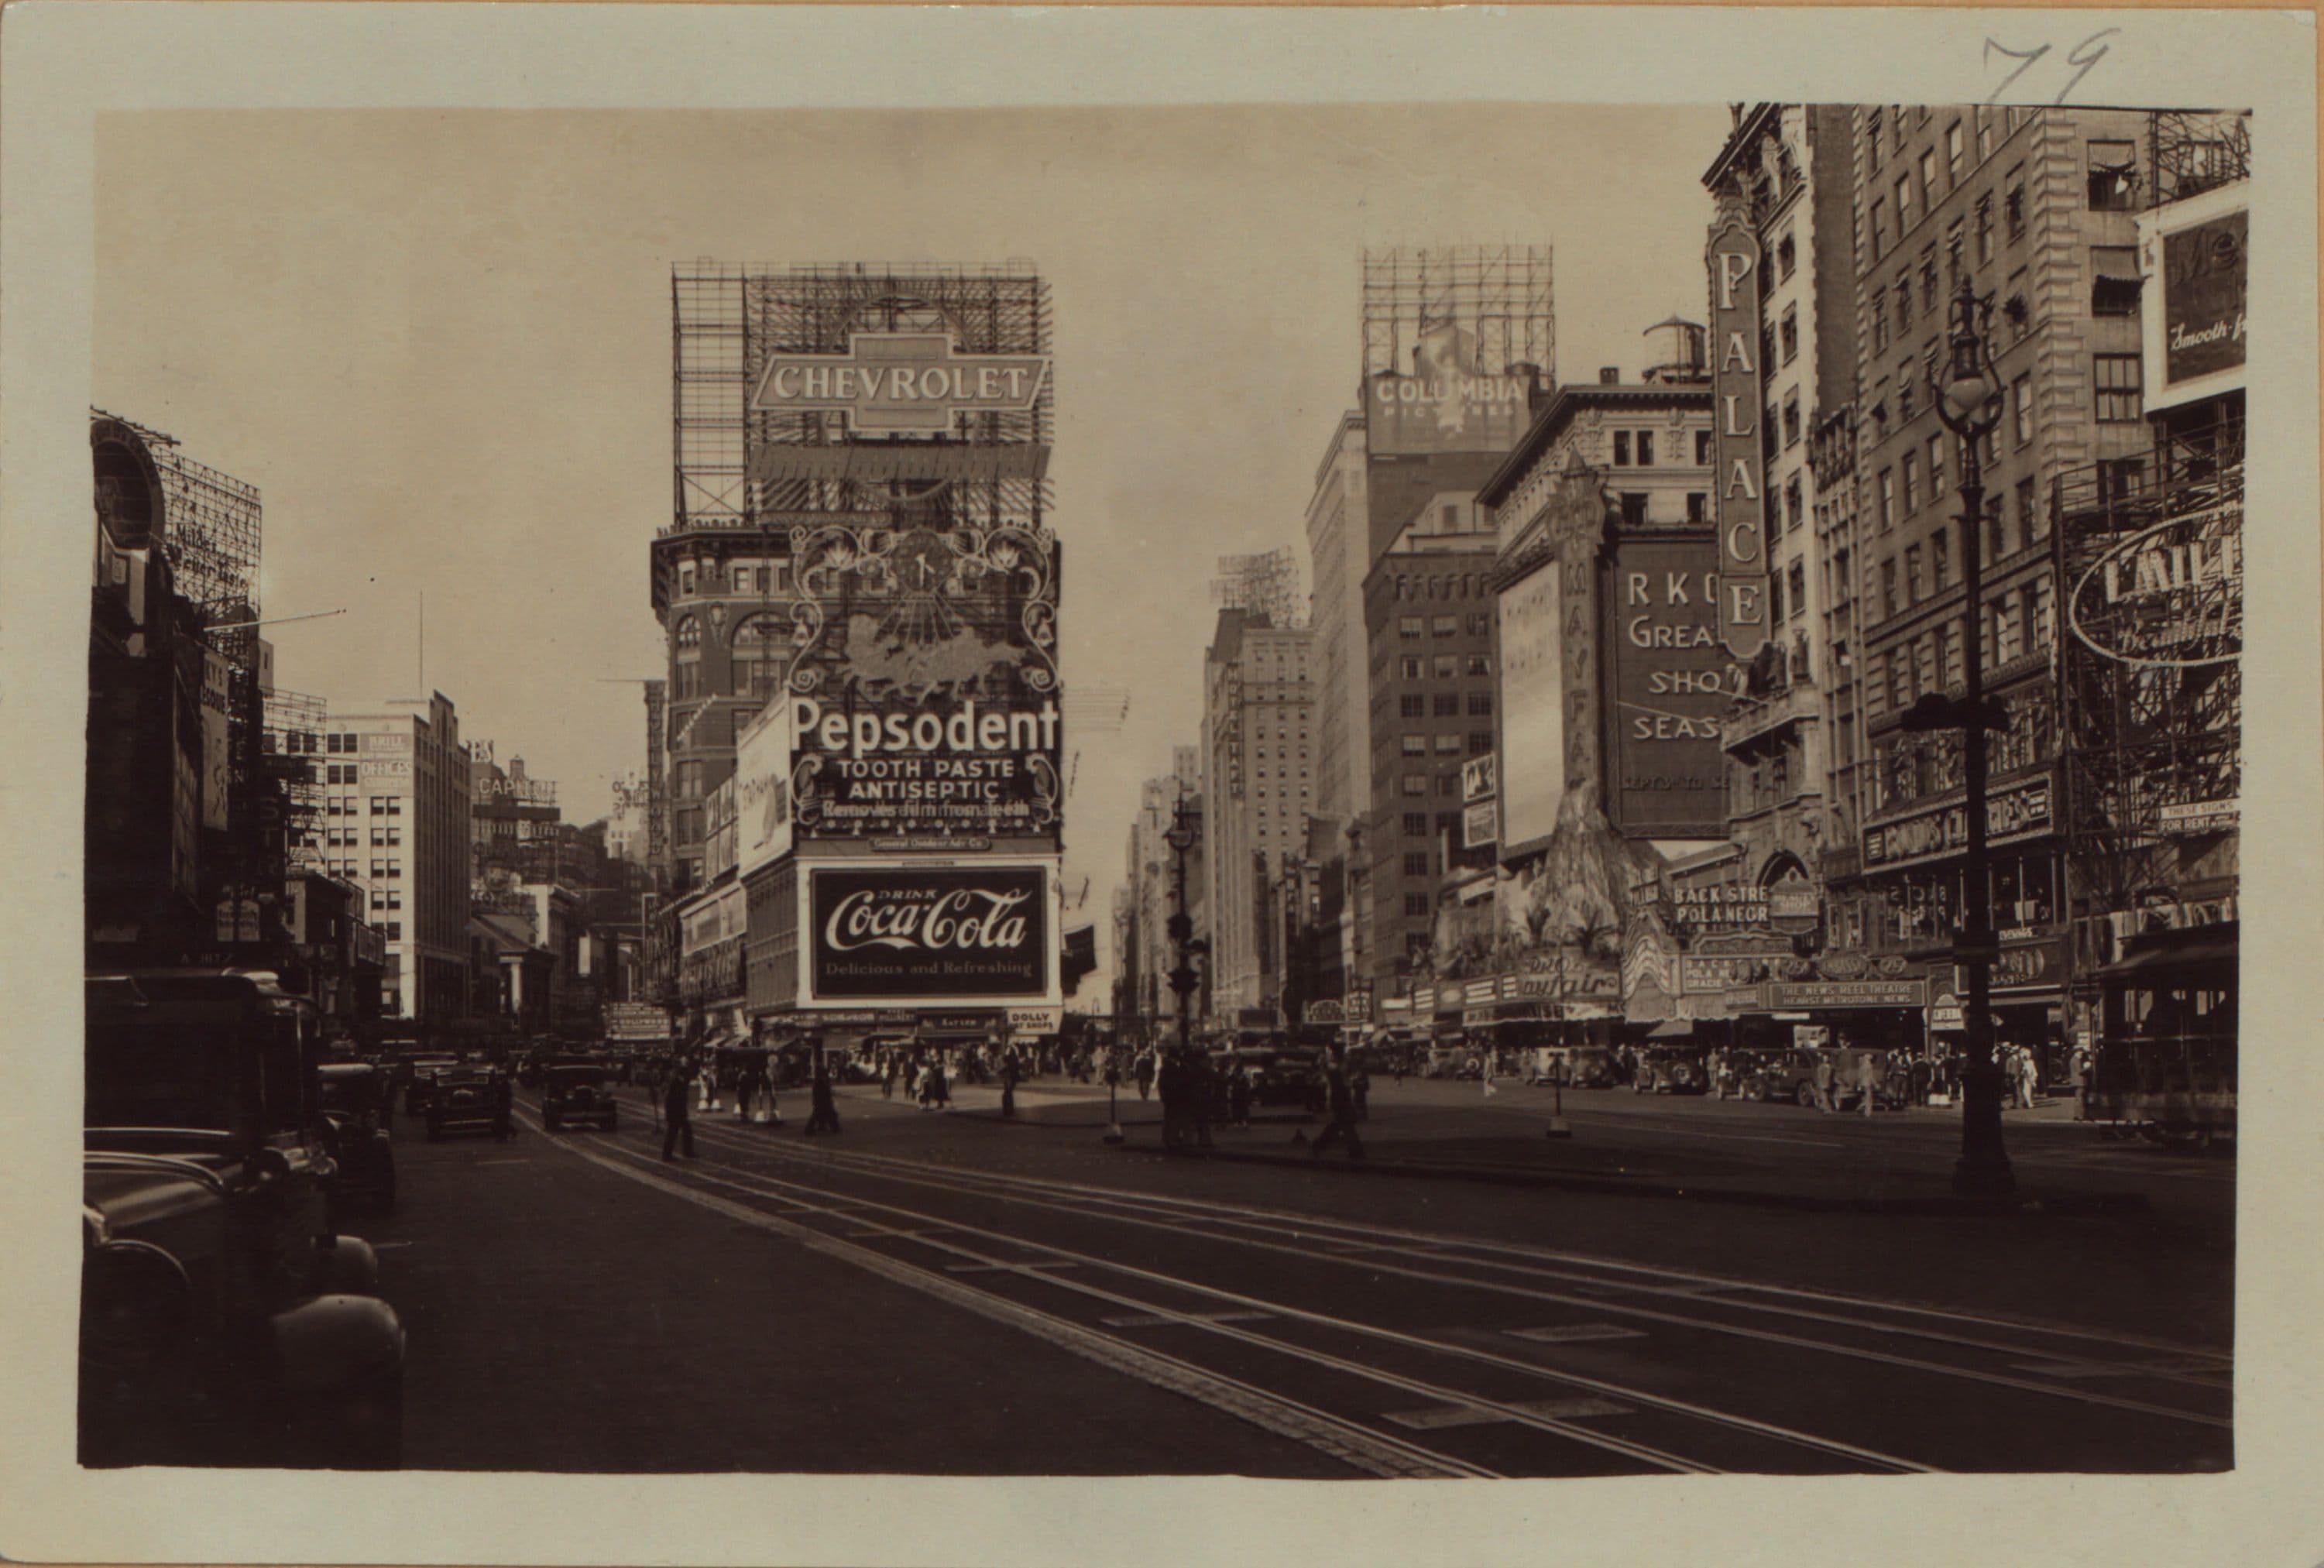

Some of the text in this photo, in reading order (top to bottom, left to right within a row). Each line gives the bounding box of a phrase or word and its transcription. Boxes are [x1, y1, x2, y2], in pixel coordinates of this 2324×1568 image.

[1983, 27, 2122, 105] 79
[774, 367, 1028, 400] CHEVROLET
[1376, 378, 1522, 403] COLUMBIA
[1718, 252, 1763, 624] PALACE
[1629, 615, 1714, 647] GREA
[1649, 671, 1720, 693] SHO
[790, 697, 1059, 758] Pepsodent
[1634, 717, 1719, 739] SEAS
[837, 759, 1014, 778] TOOTH PASTE
[850, 781, 999, 800] ANTISEPTIC
[2161, 819, 2182, 831] FOR
[2185, 817, 2210, 829] RENT
[878, 890, 938, 898] DRINK
[1674, 887, 1720, 903] BACK
[1728, 887, 1769, 903] STRE
[1677, 904, 1768, 922] POLA NEGR
[826, 961, 1032, 977] Delicious and Refreshing
[1782, 985, 1798, 995] THE
[1806, 985, 1834, 995] NEWS
[1869, 983, 1913, 993] THEATRE
[1011, 1013, 1049, 1021] DOLLY
